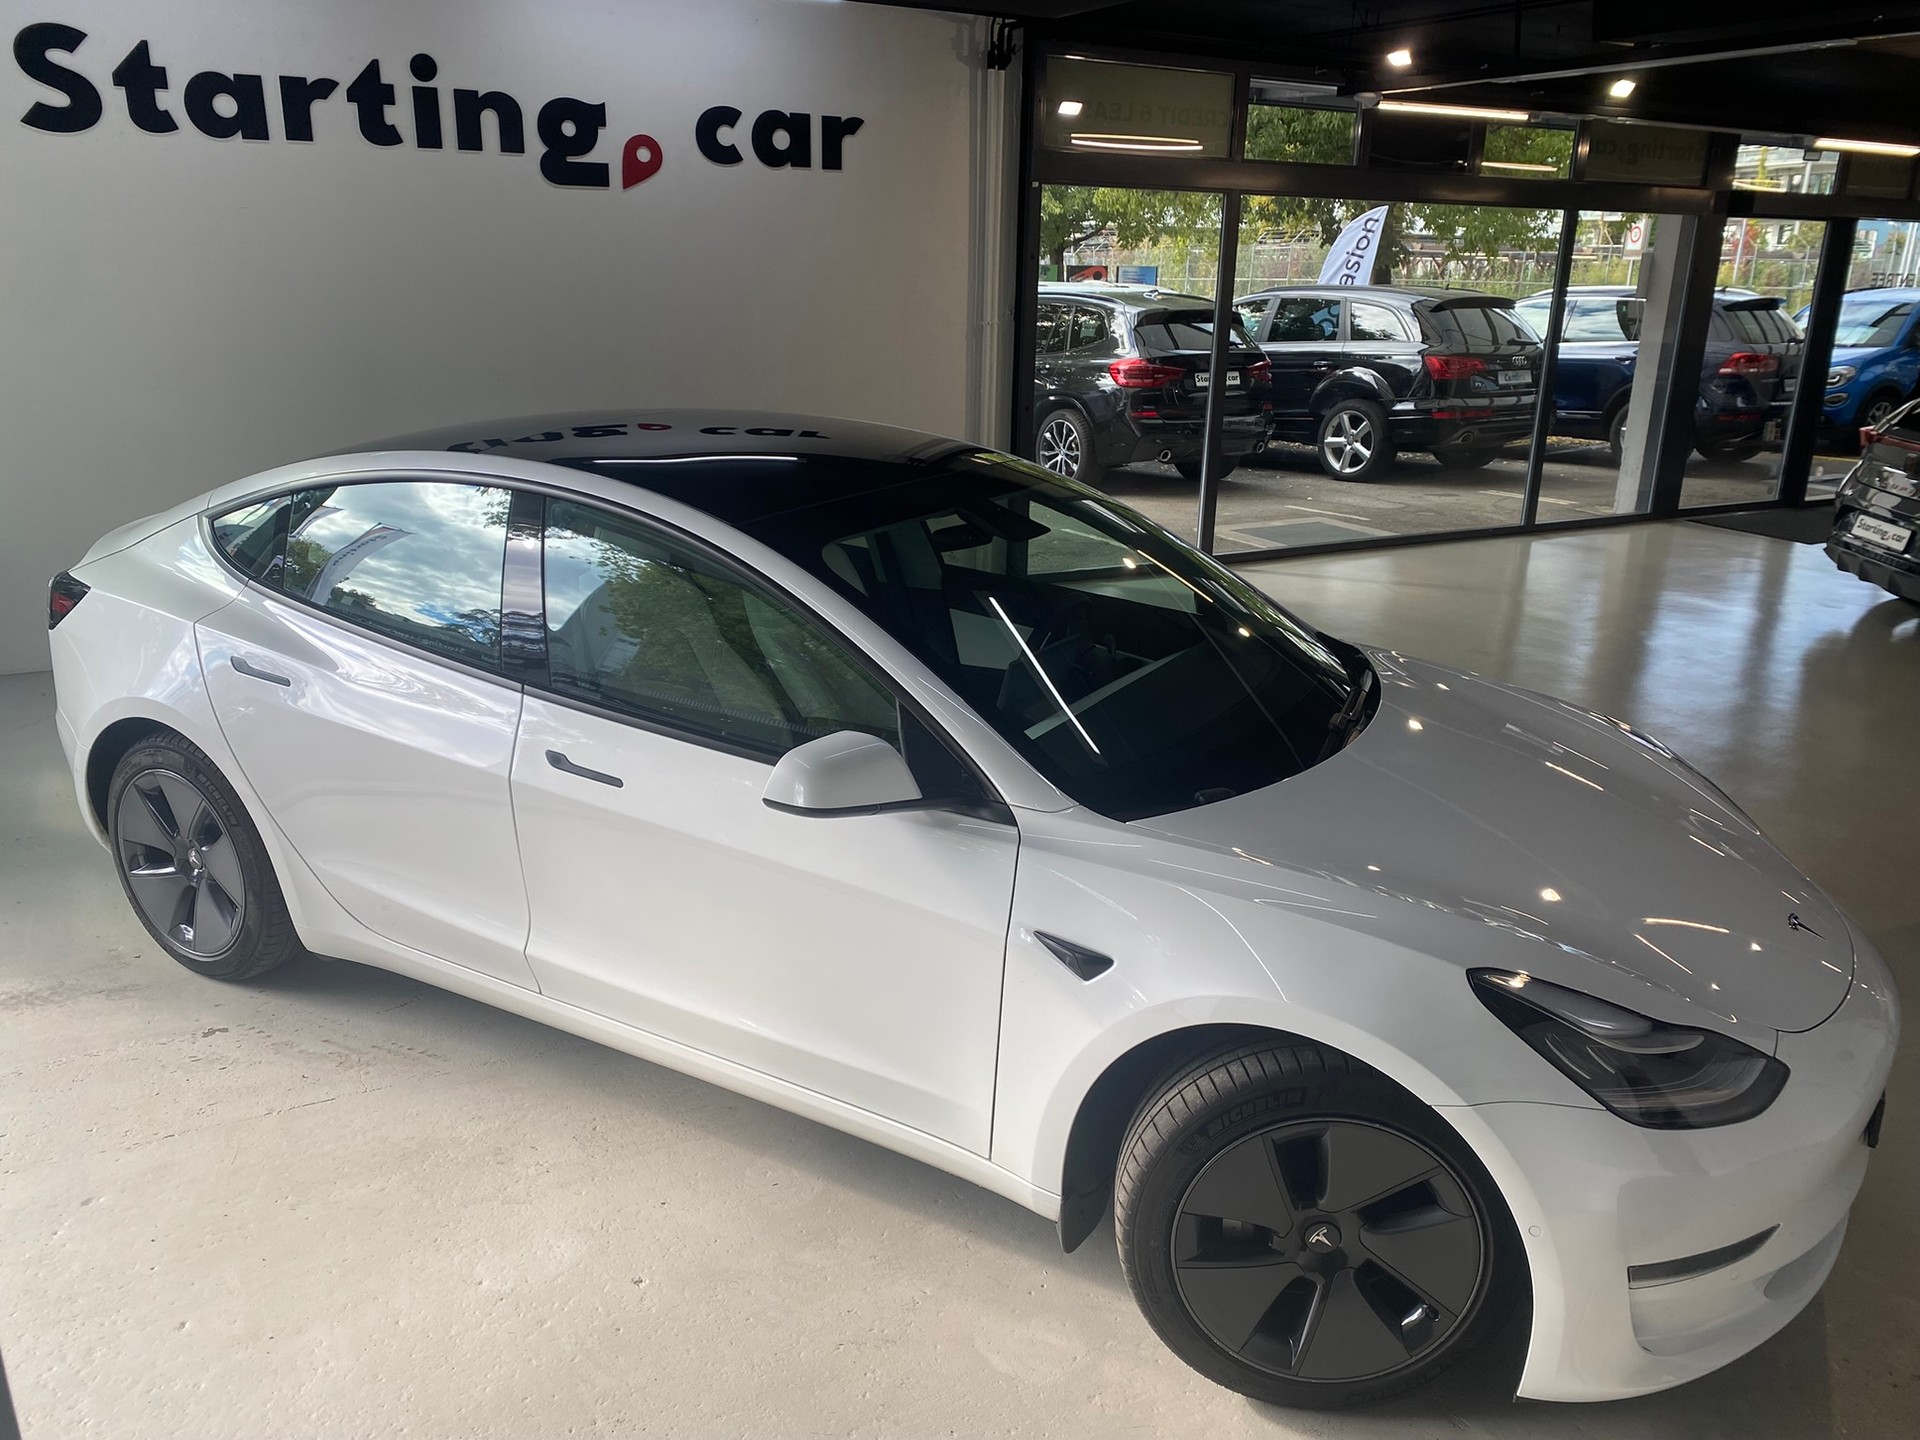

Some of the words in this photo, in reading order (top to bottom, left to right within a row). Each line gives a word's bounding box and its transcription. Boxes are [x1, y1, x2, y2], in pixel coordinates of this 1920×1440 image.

[12, 21, 611, 189] Starting
[694, 104, 867, 172] car
[1856, 518, 1889, 541] Starting
[1891, 533, 1907, 543] car
[1206, 1085, 1306, 1137] MICHELIN
